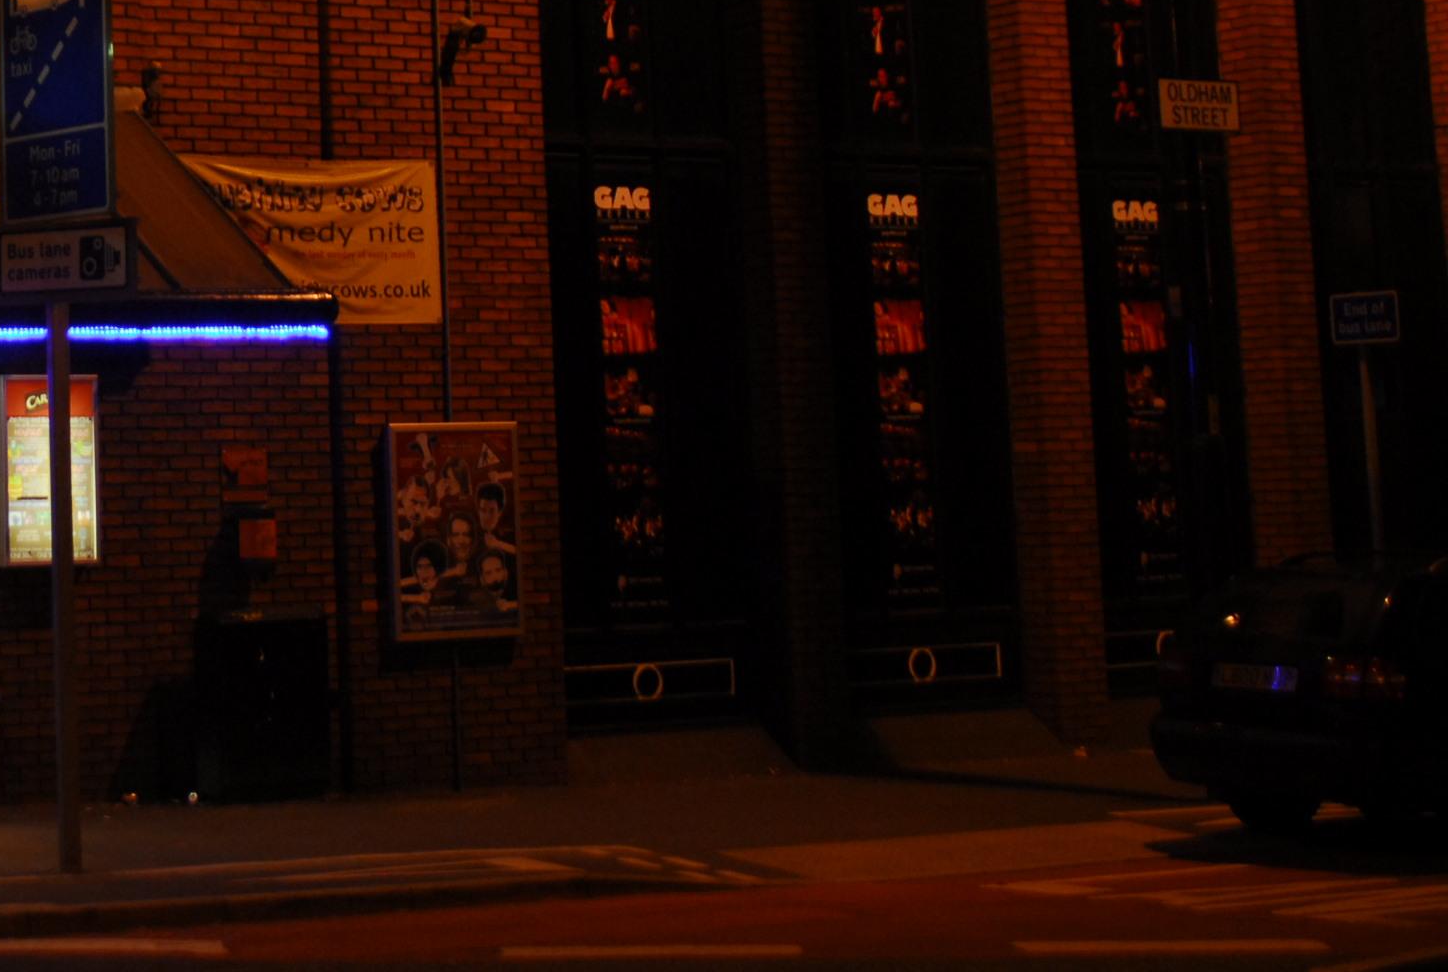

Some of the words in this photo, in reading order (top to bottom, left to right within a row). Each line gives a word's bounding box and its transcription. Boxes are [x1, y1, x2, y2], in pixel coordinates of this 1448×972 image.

[10, 59, 33, 77] taxi
[1167, 82, 1232, 104] OLDHAM
[1172, 105, 1230, 127] STREET
[594, 185, 651, 210] GAG
[866, 193, 920, 218] GAG
[1111, 199, 1160, 223] GAG
[266, 221, 353, 247] medy
[368, 221, 425, 243] nite
[7, 242, 34, 260] Bus
[39, 239, 71, 257] lane
[7, 264, 71, 281] cameras
[304, 280, 431, 298] cows.co.uk
